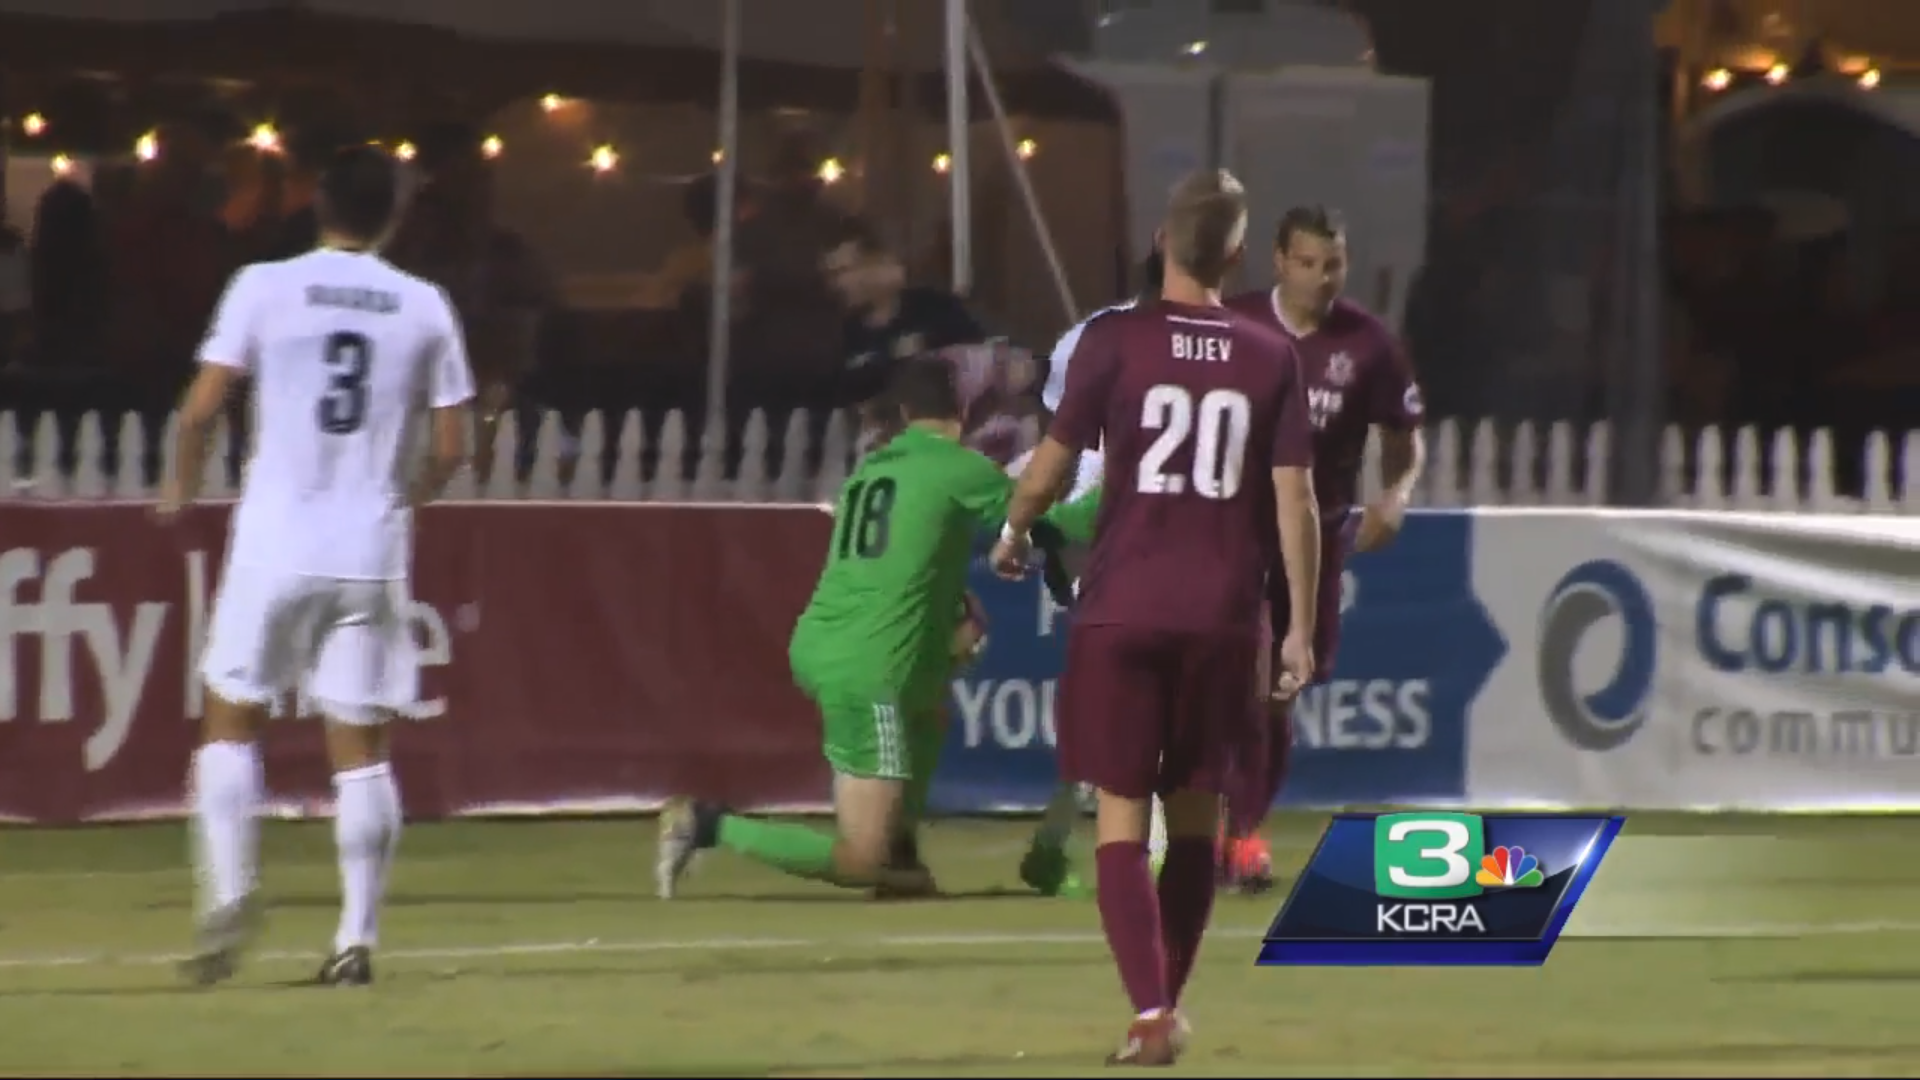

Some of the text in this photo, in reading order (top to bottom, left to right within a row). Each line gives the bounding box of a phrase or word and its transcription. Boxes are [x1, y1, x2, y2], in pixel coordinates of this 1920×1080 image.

[316, 330, 372, 435] 3
[1171, 333, 1232, 362] BIJEV
[1137, 384, 1250, 499] 20
[838, 476, 897, 560] 18
